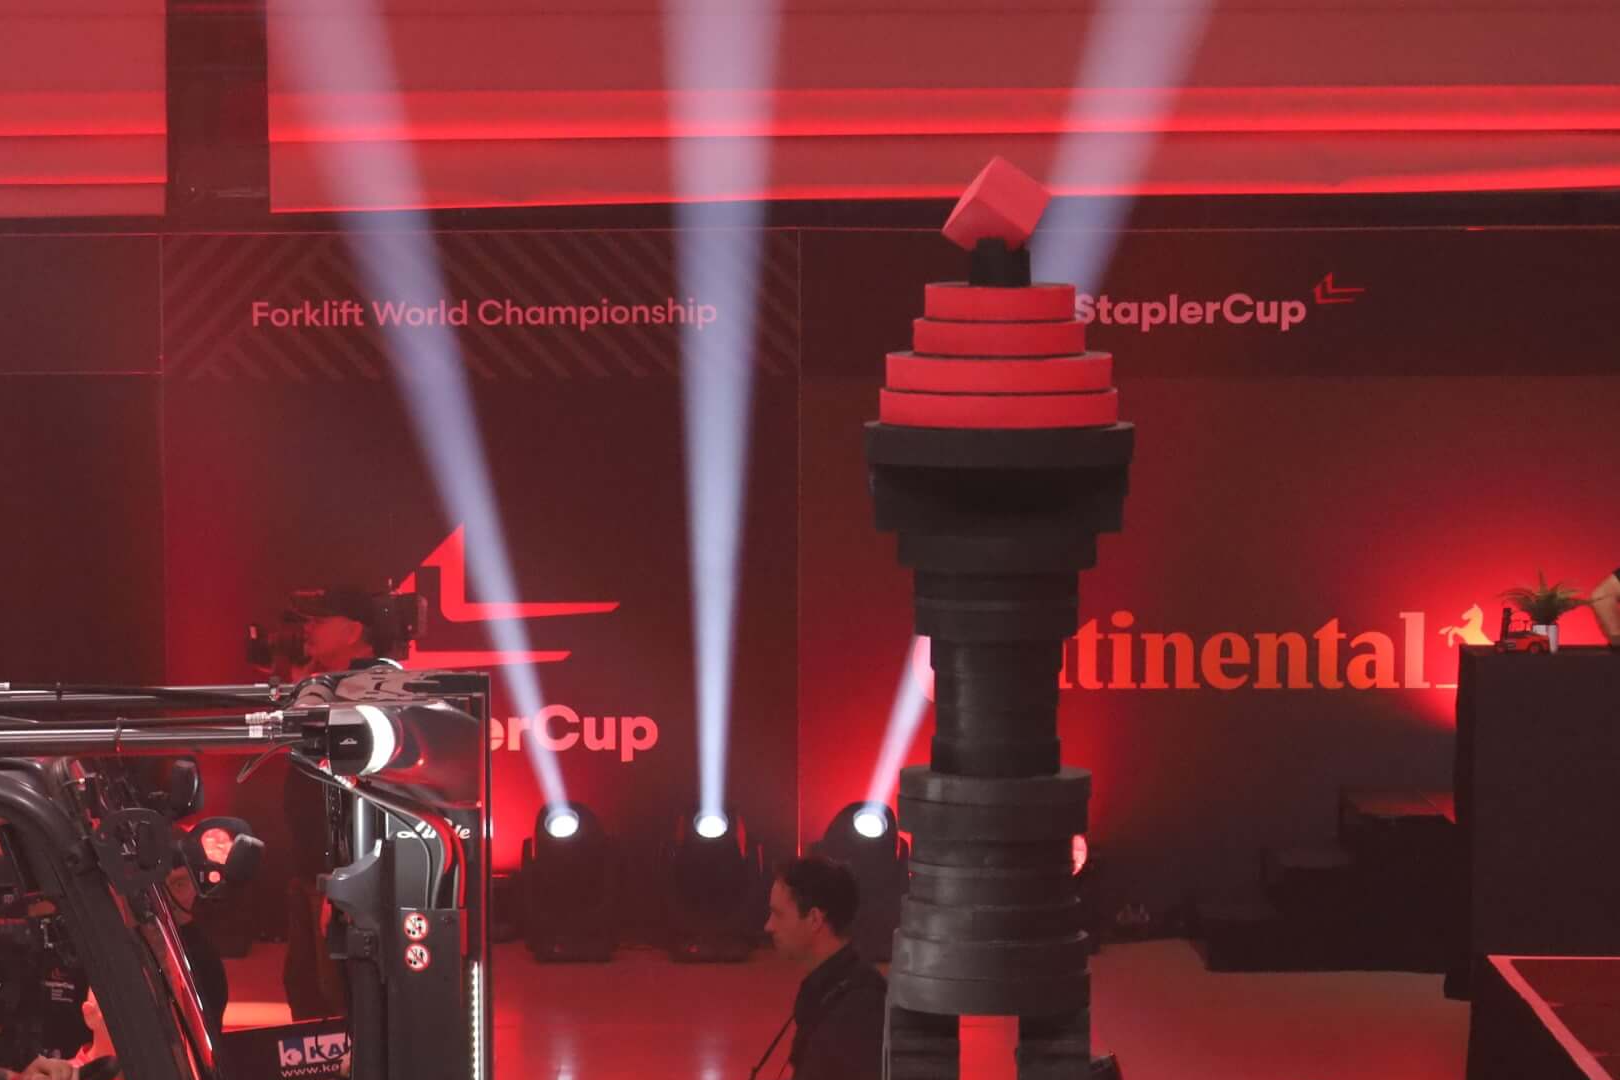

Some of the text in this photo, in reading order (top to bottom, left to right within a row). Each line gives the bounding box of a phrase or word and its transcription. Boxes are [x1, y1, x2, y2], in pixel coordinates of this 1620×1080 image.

[251, 298, 718, 331] Forklift World Championship
[1074, 293, 1307, 332] StaplerCup
[1058, 610, 1430, 689] tinental
